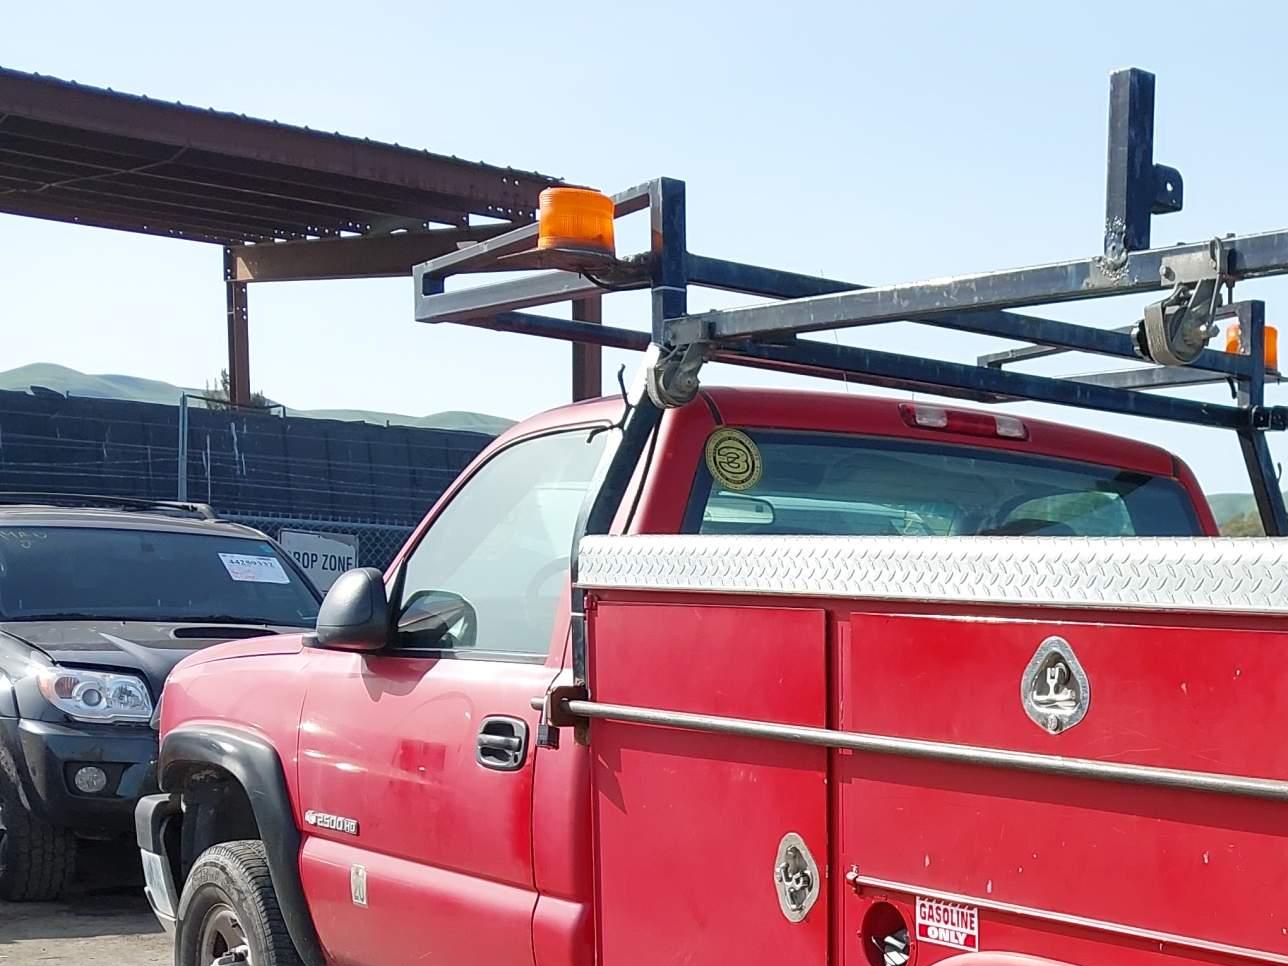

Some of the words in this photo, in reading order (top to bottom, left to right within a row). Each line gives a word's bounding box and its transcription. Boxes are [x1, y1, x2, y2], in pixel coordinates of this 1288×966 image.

[287, 551, 318, 569] ROP
[321, 553, 353, 573] ZONE
[920, 902, 976, 931] GASOLINE
[927, 926, 967, 946] ONLY
